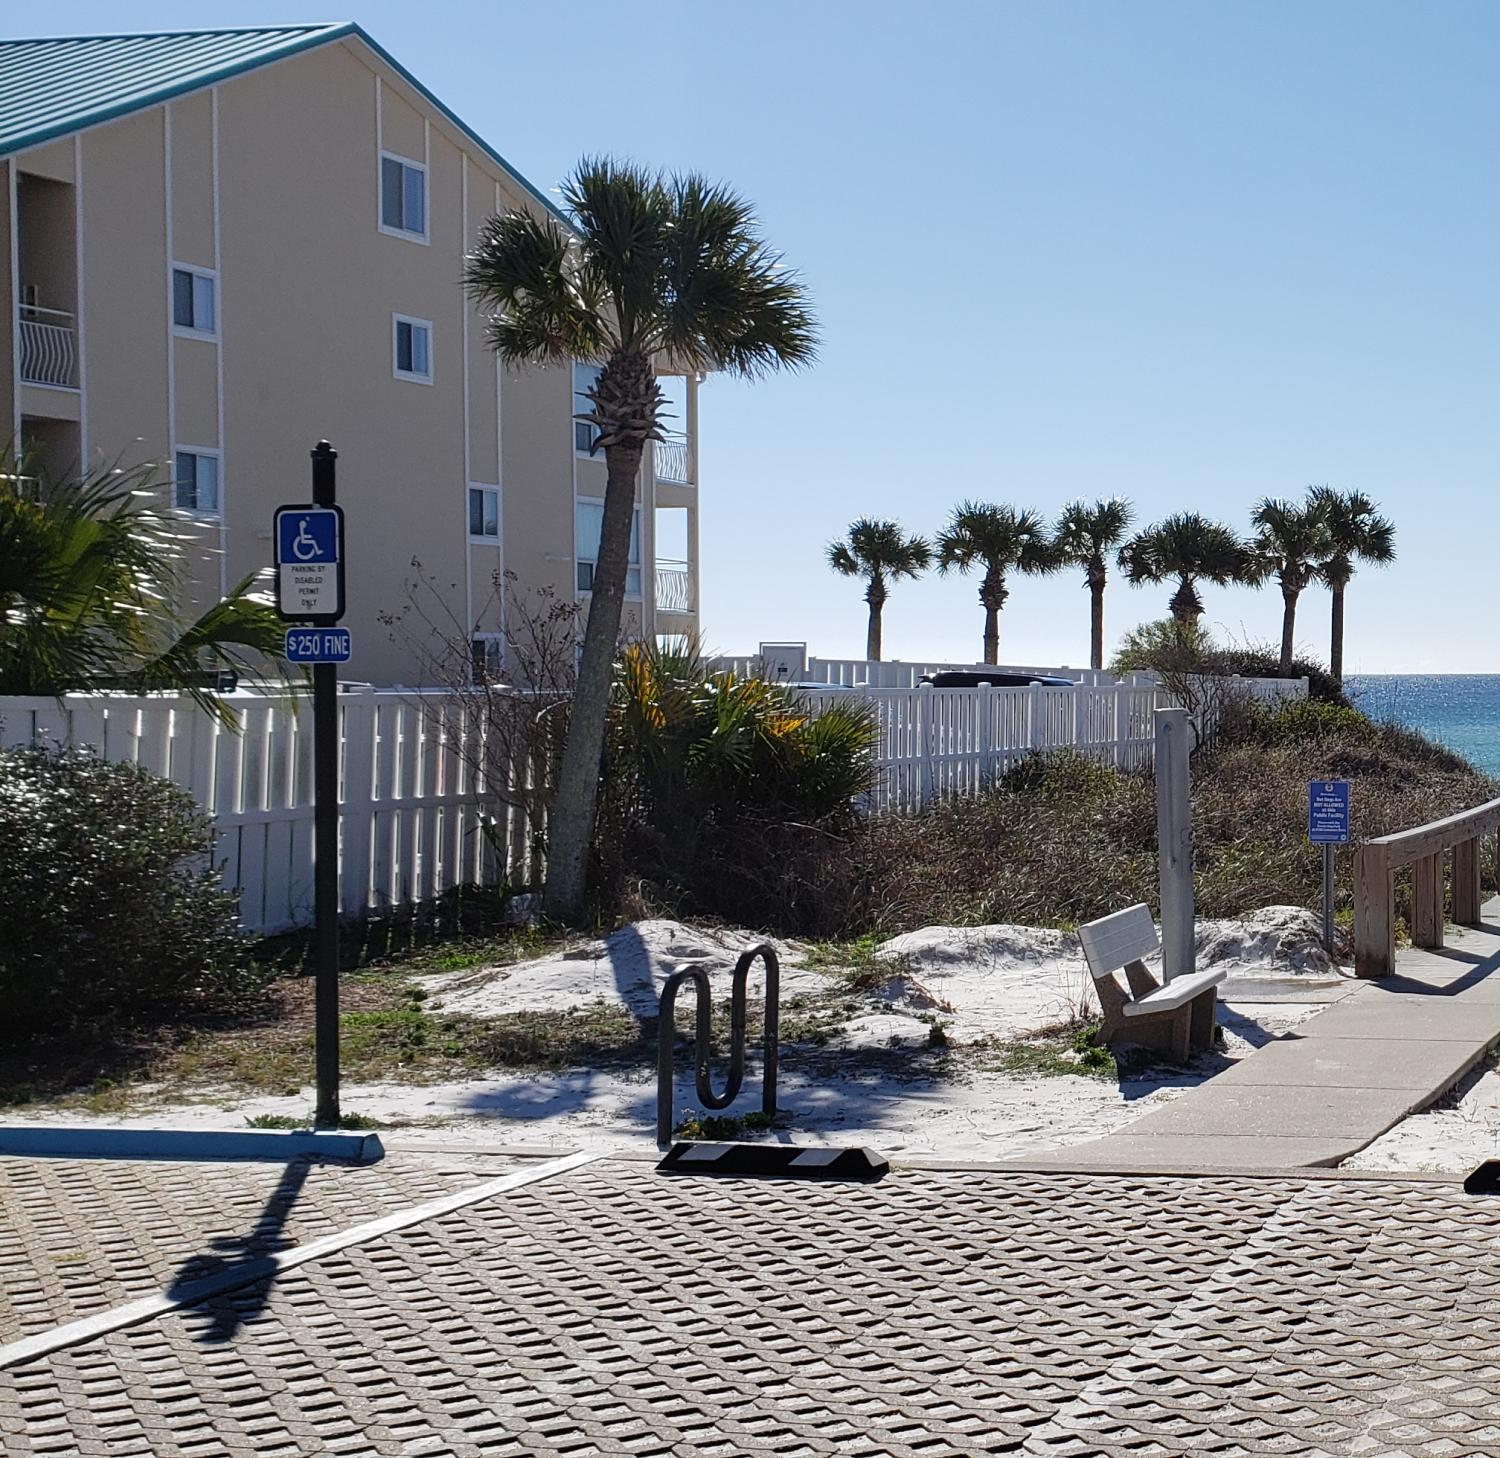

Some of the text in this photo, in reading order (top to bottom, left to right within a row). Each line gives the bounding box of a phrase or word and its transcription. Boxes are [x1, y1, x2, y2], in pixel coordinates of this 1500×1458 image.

[291, 565, 326, 573] PARKING BY
[294, 576, 324, 585] DISABLED
[298, 587, 319, 596] PERMIT
[301, 599, 317, 607] ONLY
[324, 635, 349, 656] FINE
